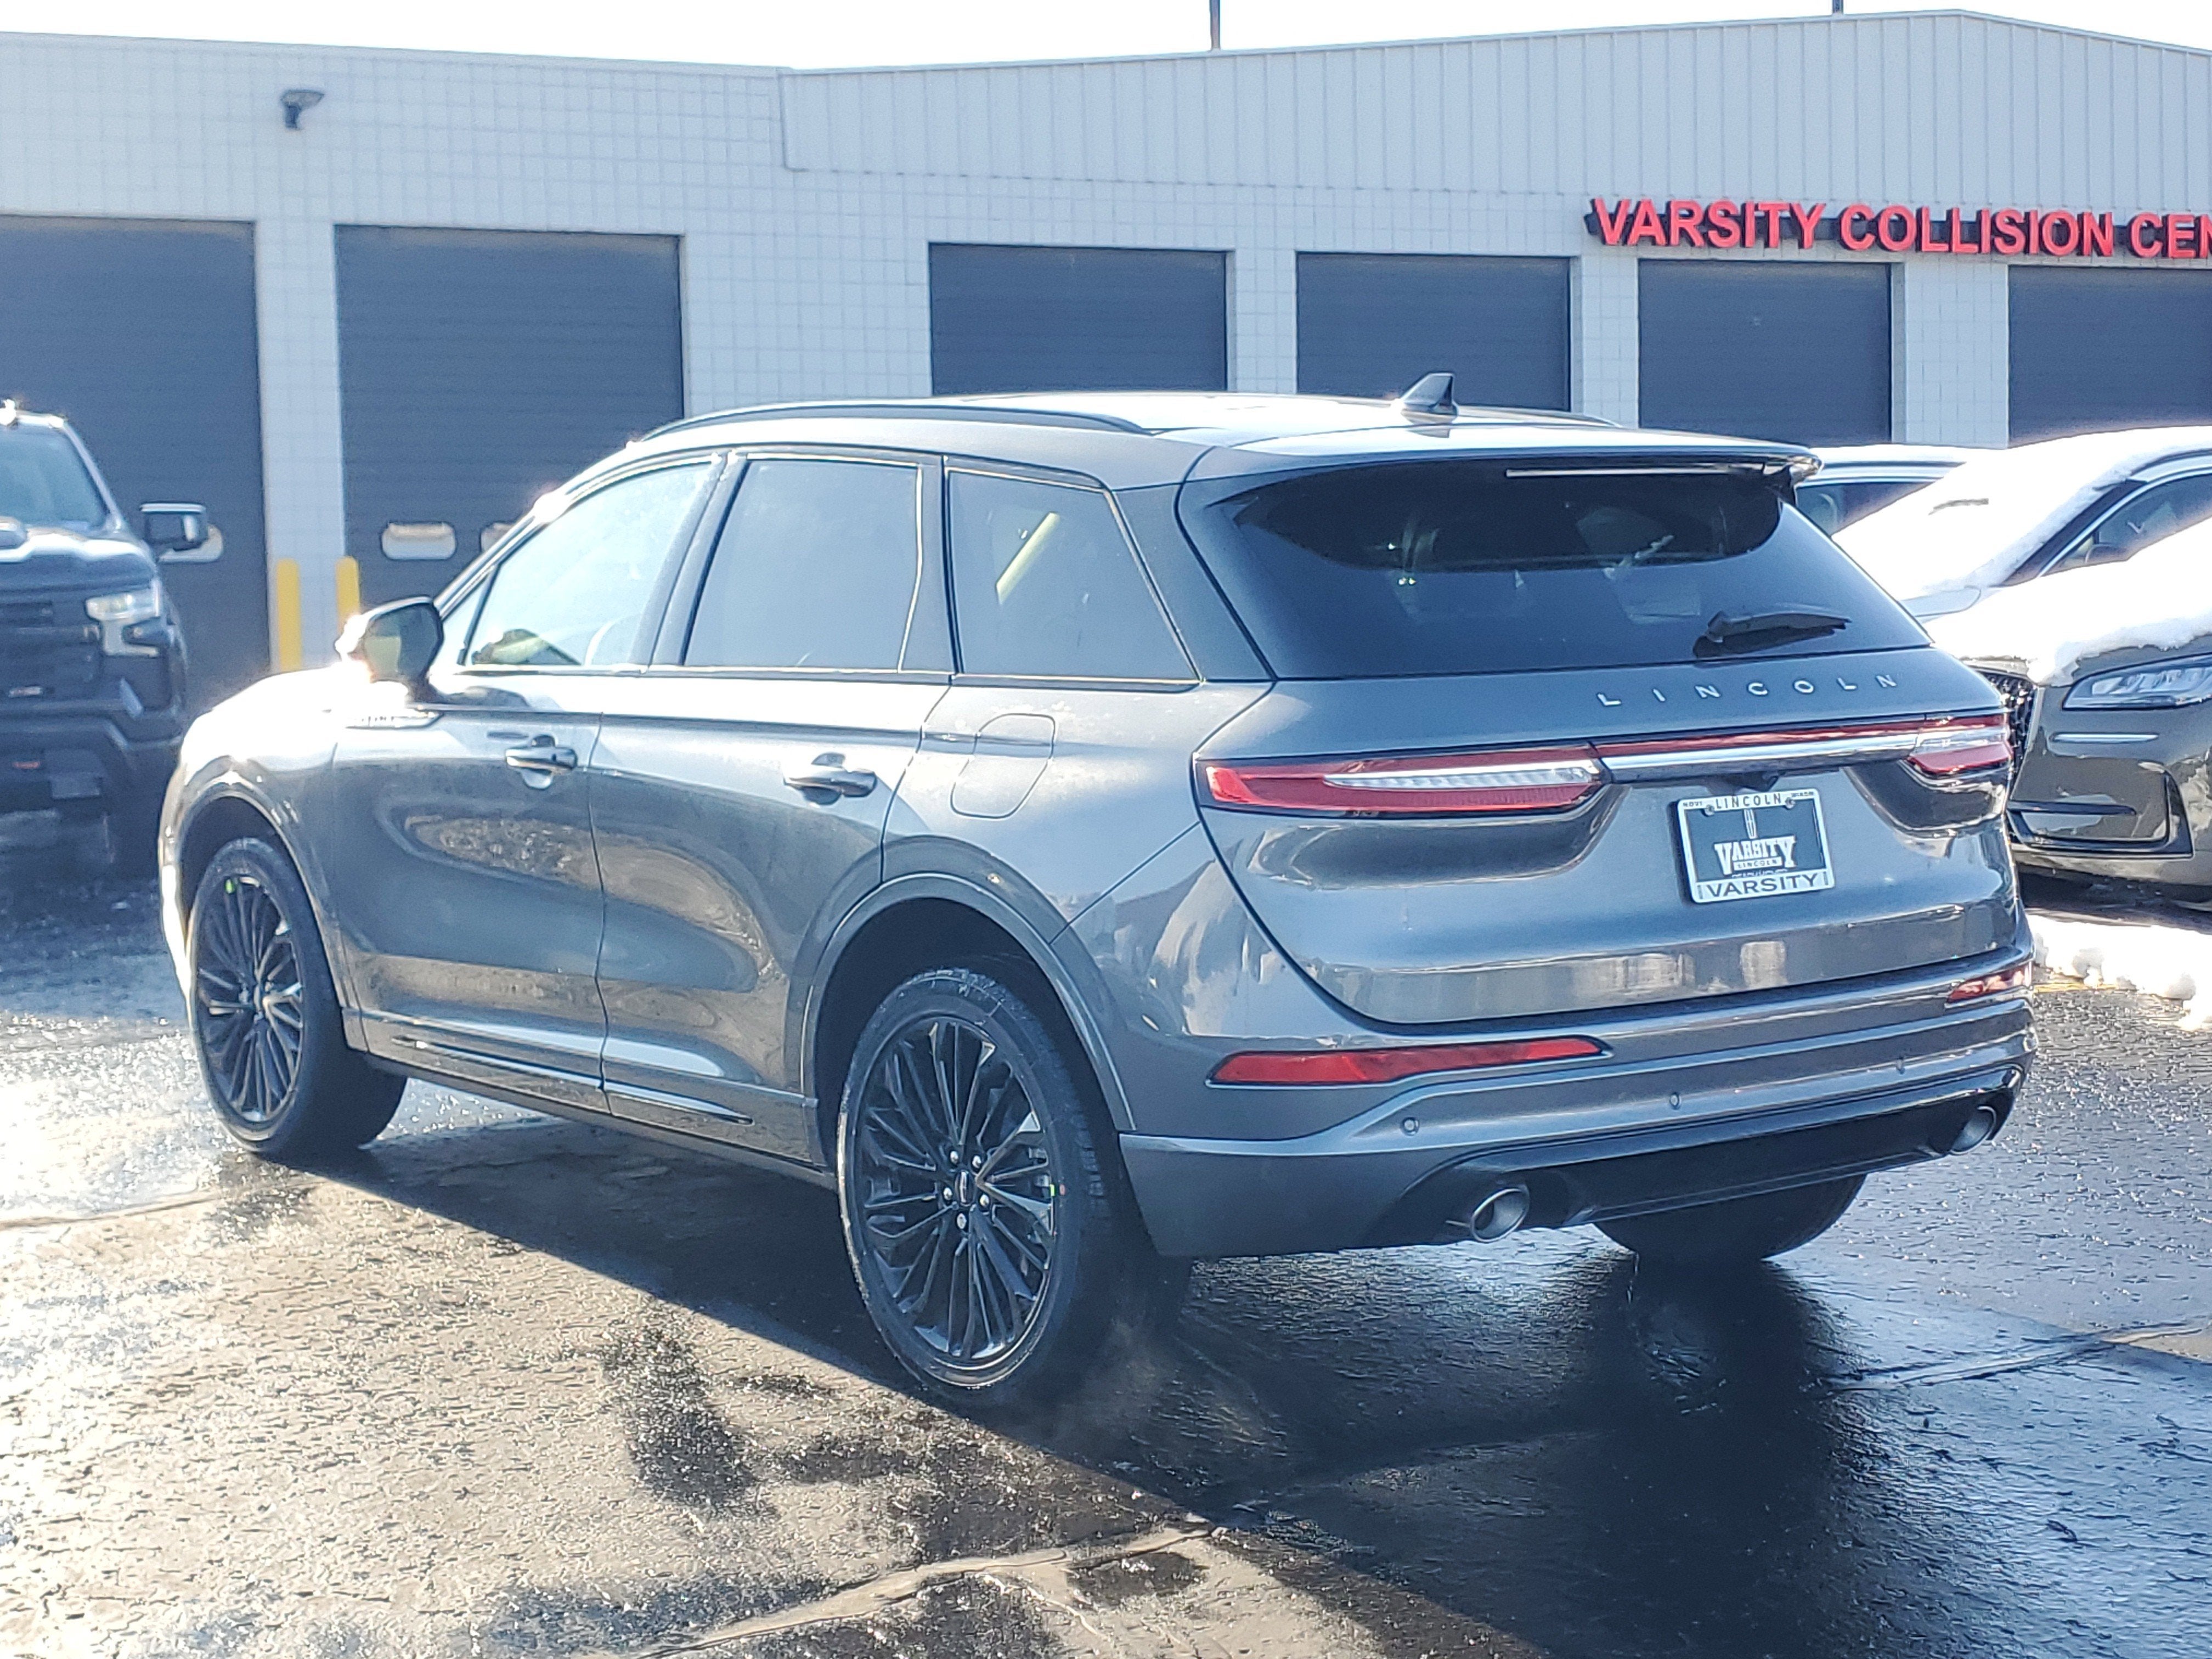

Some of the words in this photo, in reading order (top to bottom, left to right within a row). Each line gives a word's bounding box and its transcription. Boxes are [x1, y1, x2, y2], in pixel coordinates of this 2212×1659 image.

[1591, 197, 1826, 250] VARSITY
[1839, 205, 2113, 257] COLLISION
[1597, 674, 1897, 707] LINCOLN
[1715, 793, 1781, 809] LINCOLN
[1714, 834, 1796, 876] VARSITY
[1737, 859, 1778, 868] LINCOLN
[1706, 873, 1818, 898] VARSITY
